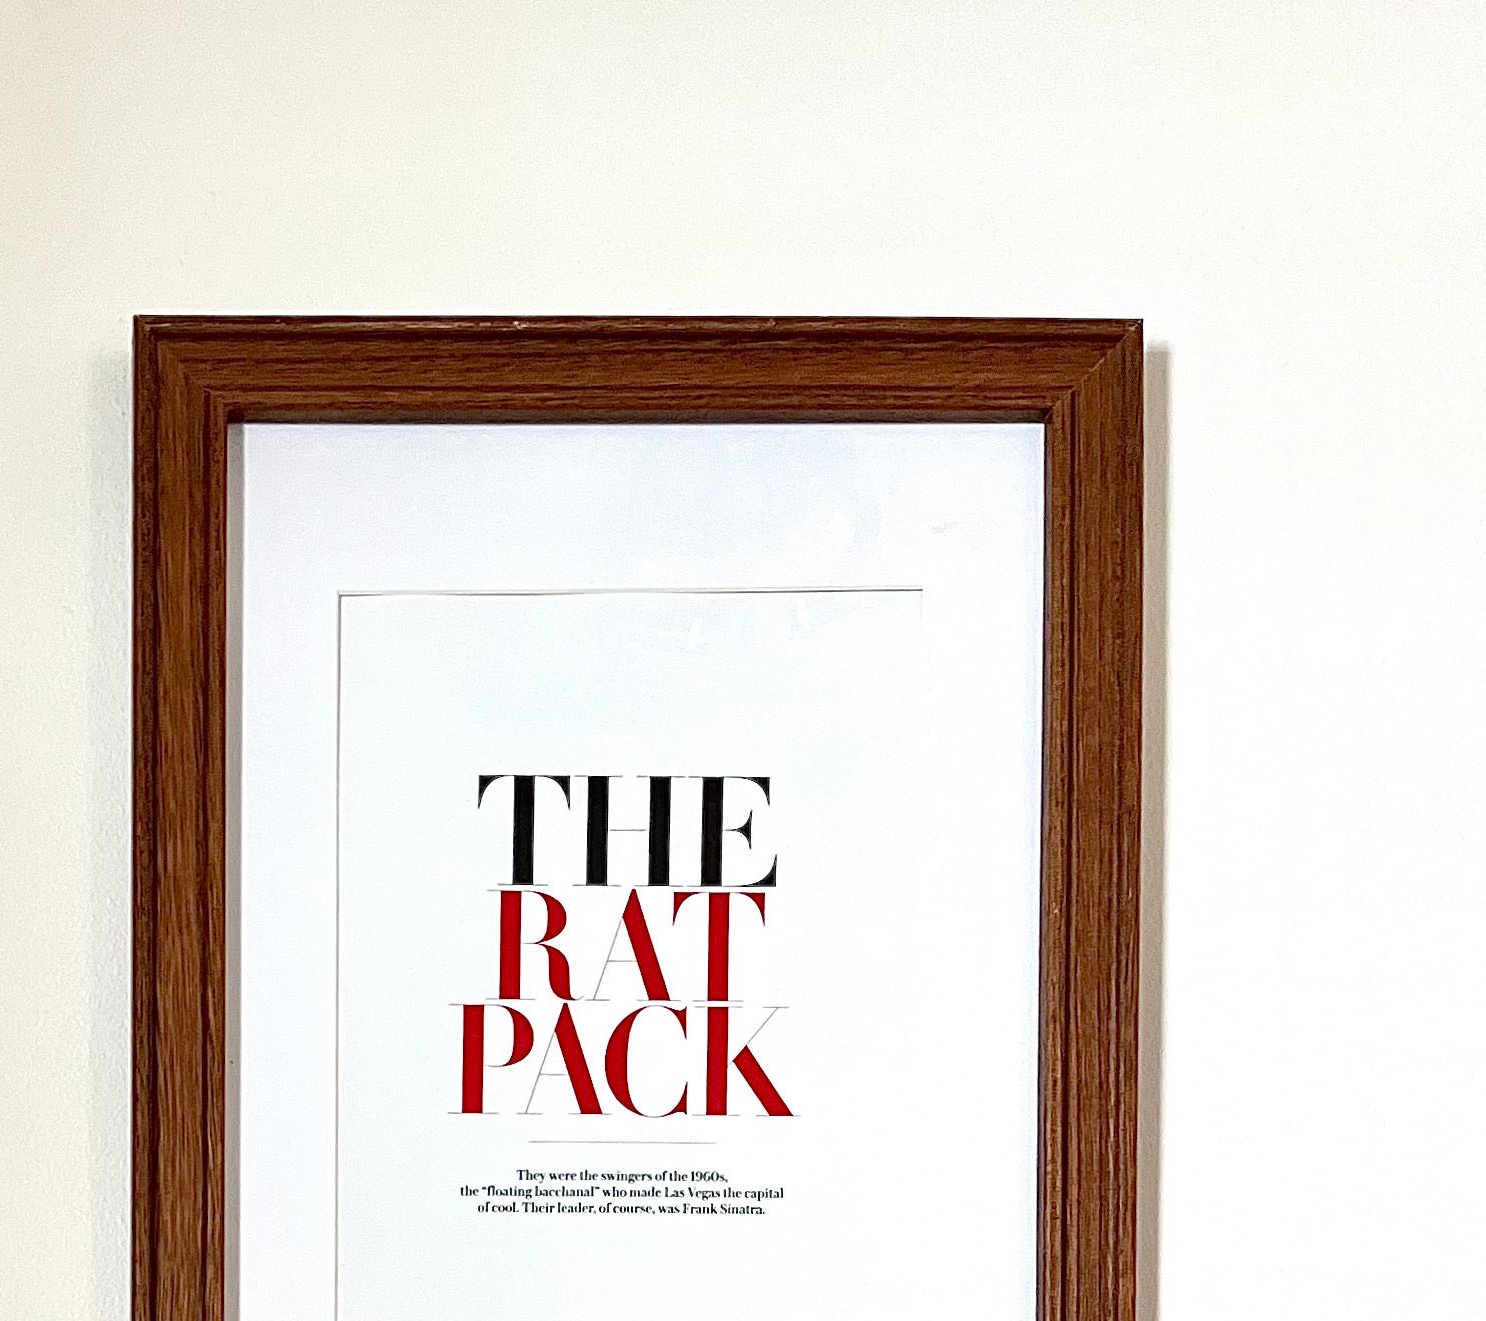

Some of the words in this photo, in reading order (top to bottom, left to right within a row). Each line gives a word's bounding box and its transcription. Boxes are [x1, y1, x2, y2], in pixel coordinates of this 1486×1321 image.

[478, 774, 778, 888] THE
[485, 888, 767, 1002] RAT
[447, 1002, 802, 1118] PACK
[460, 1185, 480, 1197] the
[482, 1185, 533, 1200] "floating
[535, 1186, 601, 1198] bacchanal"
[602, 1186, 628, 1198] who
[629, 1187, 662, 1198] made
[664, 1187, 685, 1198] Las
[688, 1187, 721, 1201] Vegas
[723, 1187, 743, 1199] the
[744, 1187, 785, 1201] capital
[477, 1201, 491, 1213] of
[491, 1202, 519, 1213] cool.
[521, 1202, 555, 1213] Their
[557, 1202, 597, 1215] leader,
[598, 1202, 612, 1214] of
[612, 1204, 656, 1215] course,
[658, 1205, 680, 1214] was
[682, 1203, 718, 1215] Frank
[719, 1203, 766, 1215] Sinatra.
[516, 1169, 546, 1184] They
[549, 1172, 577, 1182] were
[579, 1169, 599, 1182] the
[601, 1170, 653, 1184] swingers
[654, 1170, 668, 1182] of
[669, 1170, 688, 1182] the
[690, 1170, 729, 1184] 1960s,
